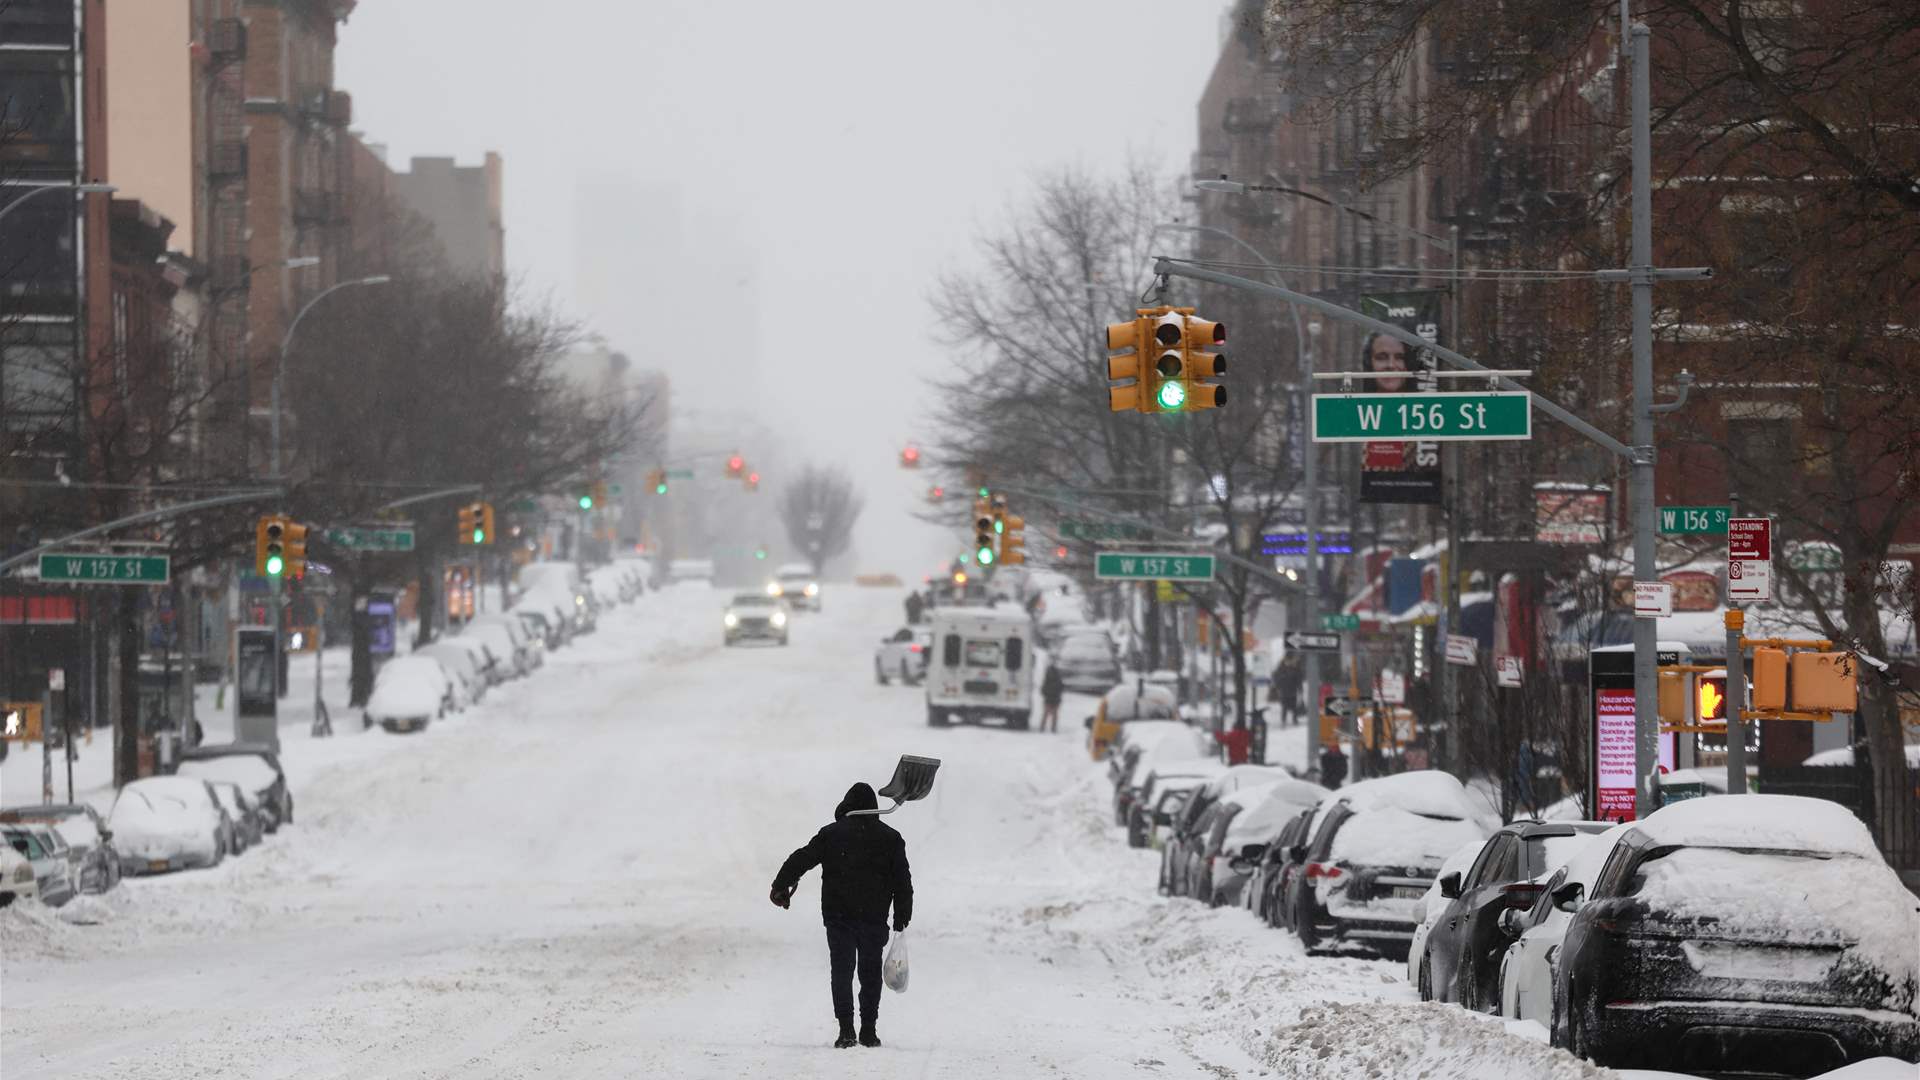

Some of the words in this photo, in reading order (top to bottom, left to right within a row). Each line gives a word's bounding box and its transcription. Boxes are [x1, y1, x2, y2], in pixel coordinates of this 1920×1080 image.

[1357, 404, 1383, 430] W
[1397, 403, 1445, 430] 156
[1459, 402, 1487, 429] St
[1663, 511, 1676, 530] W
[1683, 511, 1709, 530] 156
[1715, 510, 1726, 522] St
[1739, 523, 1763, 531] STANDING
[66, 560, 82, 577] W
[91, 560, 117, 578] 157
[125, 560, 142, 578] St
[1120, 560, 1136, 573] W
[1143, 560, 1167, 574] 157
[1174, 560, 1190, 575] St
[1659, 653, 1677, 661] NYC
